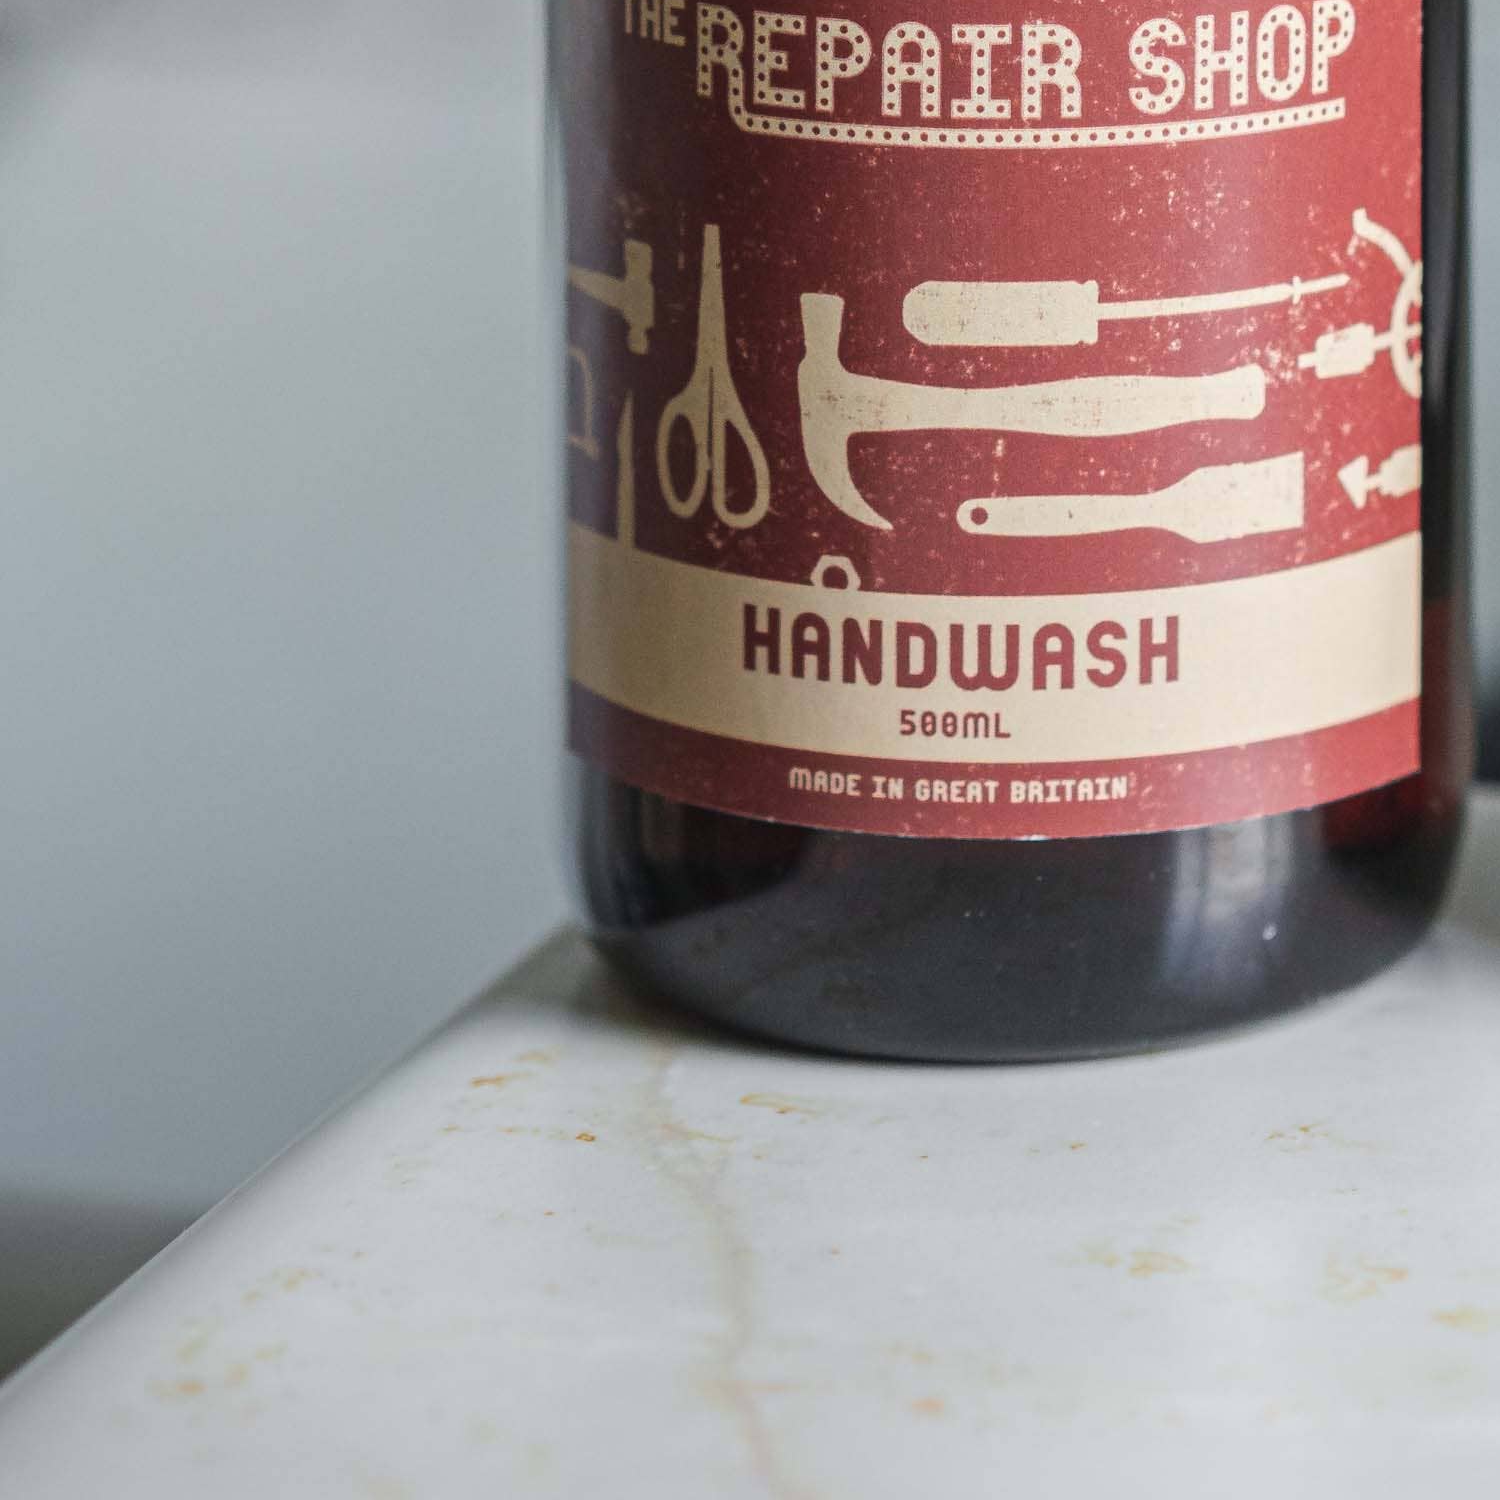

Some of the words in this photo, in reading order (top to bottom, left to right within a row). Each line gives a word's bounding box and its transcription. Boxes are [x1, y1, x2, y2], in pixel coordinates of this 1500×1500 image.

[696, 5, 1082, 120] REPAIR
[743, 603, 1180, 691] HANDWASH
[899, 709, 1011, 740] 500ML
[789, 767, 861, 798] MADE
[872, 773, 905, 802] IN
[915, 777, 999, 804] GREAT
[1011, 775, 1128, 803] BRITAIN
